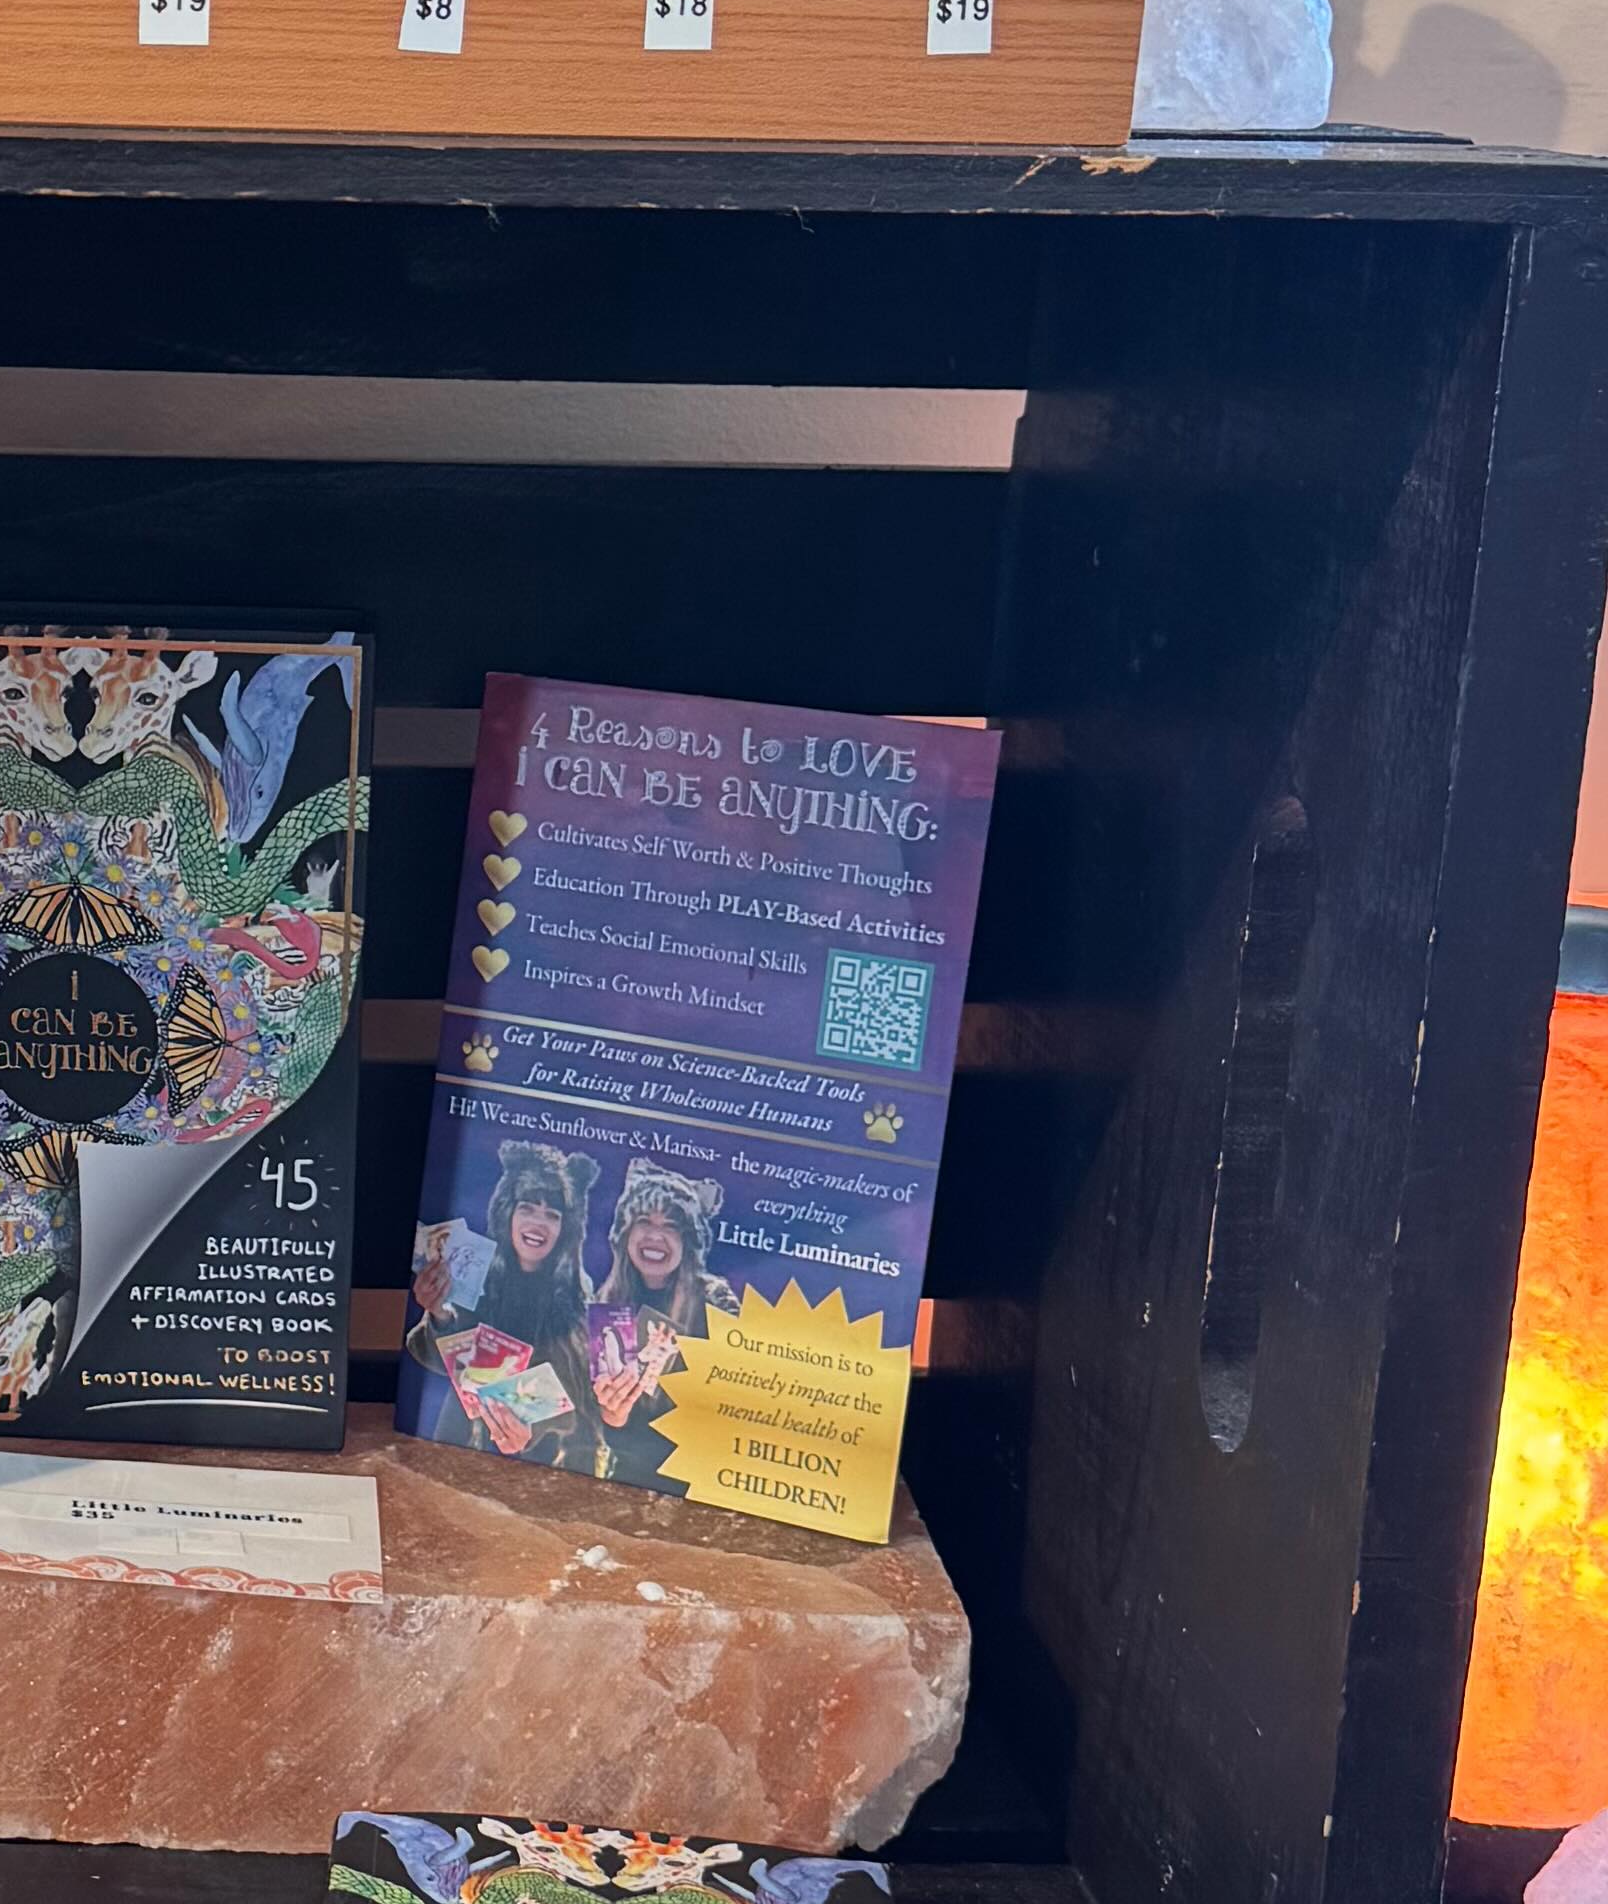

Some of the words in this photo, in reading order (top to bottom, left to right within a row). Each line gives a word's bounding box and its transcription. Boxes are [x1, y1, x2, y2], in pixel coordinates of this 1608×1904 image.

[531, 713, 549, 749] 4
[567, 707, 721, 759] Reasons
[743, 728, 782, 764] to
[800, 736, 916, 782] LOVE
[640, 768, 701, 808] BE
[538, 823, 628, 851] Cultivates
[632, 835, 666, 856] Self
[673, 840, 730, 865] Worth
[736, 852, 753, 869] &
[760, 852, 832, 880] Positive
[838, 863, 931, 897] Thoughts
[534, 868, 623, 897] Education
[631, 881, 710, 915] Through
[718, 894, 842, 929] PLAY-Based
[847, 914, 944, 944] Activities
[526, 914, 595, 940] Teaches
[600, 926, 653, 950] Social
[659, 934, 754, 966] Emotional
[759, 951, 806, 974] Skills
[525, 960, 592, 988] Inspires
[597, 978, 605, 990] a
[612, 974, 682, 1002] Growth
[689, 986, 764, 1015] Mindset
[92, 1012, 137, 1037] BE
[261, 1157, 317, 1210] 45
[205, 1237, 335, 1259] BEAUTIFULLY
[718, 1221, 774, 1251] Little
[779, 1234, 900, 1276] Luminaries
[198, 1264, 334, 1283] ILLUSTRATED
[130, 1287, 265, 1304] AFFIRMATION
[276, 1291, 335, 1306] CARDS
[155, 1314, 262, 1334] DISCOVERY
[272, 1318, 332, 1332] BOOK
[218, 1348, 248, 1363] TO
[258, 1349, 329, 1364] BOOST
[727, 1329, 764, 1352] Our
[767, 1344, 832, 1368] mission
[838, 1354, 850, 1371] is
[856, 1362, 873, 1376] to
[82, 1371, 213, 1386] EMOTIONAL
[219, 1373, 334, 1395] WELLNESS!
[734, 1438, 740, 1454] 1
[748, 1440, 841, 1477] BILLION
[718, 1468, 846, 1514] CHILDREN!
[72, 1500, 146, 1513] Little
[158, 1507, 303, 1524] Luminaries
[72, 1510, 116, 1520] $35
